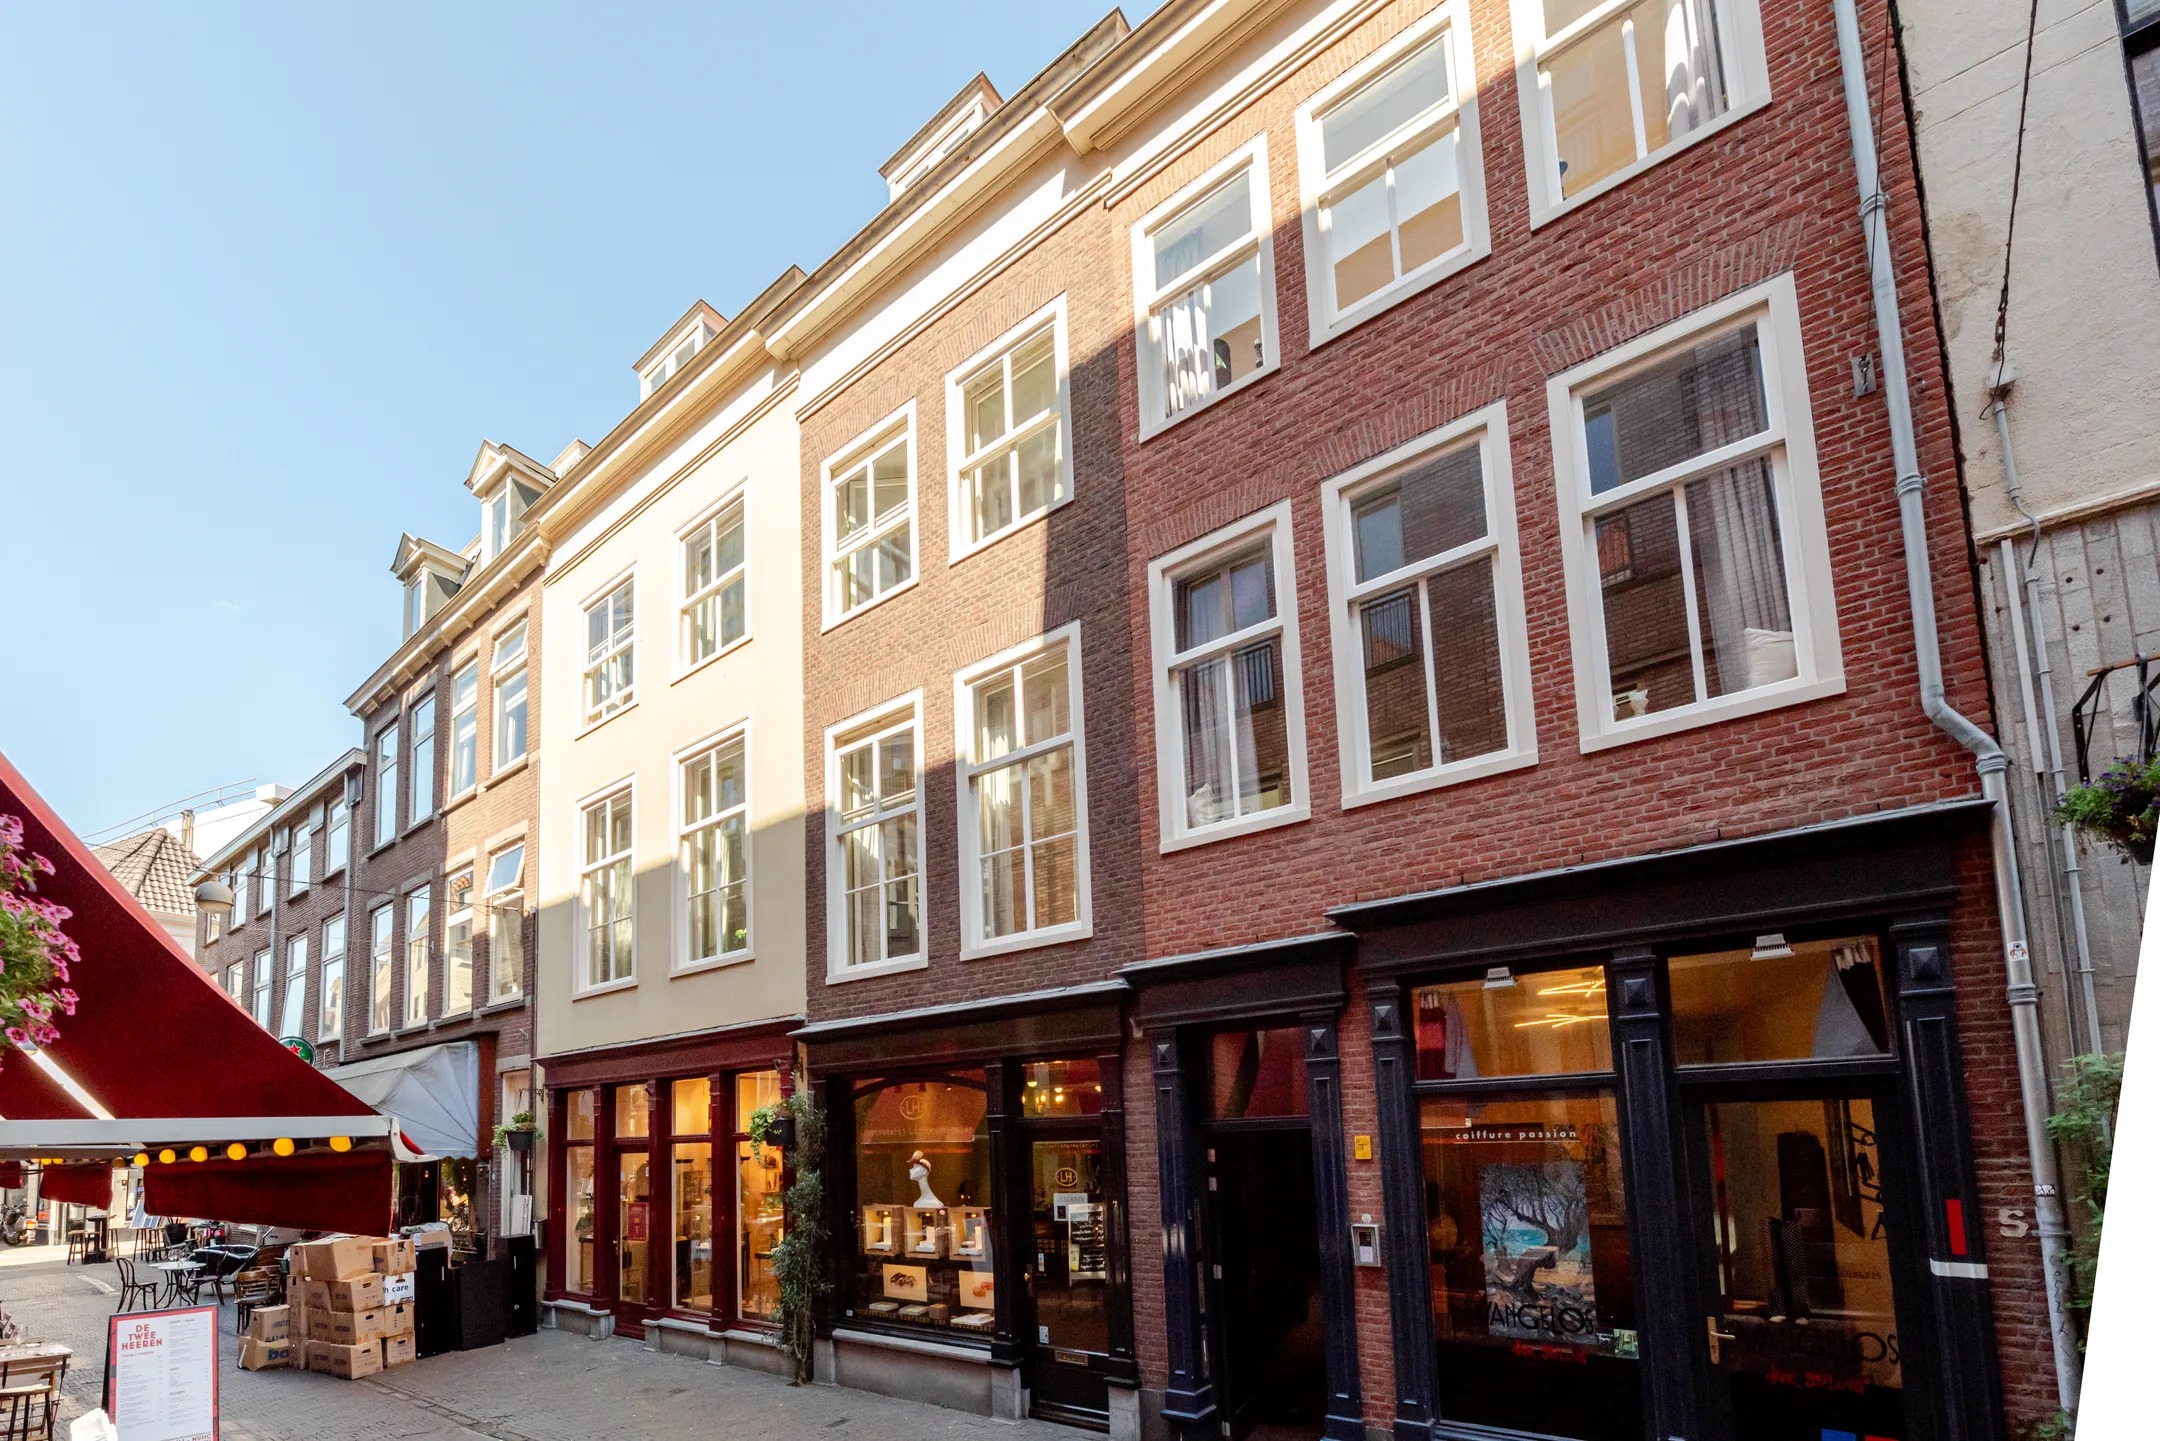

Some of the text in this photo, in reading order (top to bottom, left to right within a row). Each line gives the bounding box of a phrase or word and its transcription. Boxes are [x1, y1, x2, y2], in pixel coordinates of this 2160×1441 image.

[1455, 1129, 1577, 1140] coiffure passion
[392, 1285, 409, 1293] care
[135, 1324, 150, 1333] DE
[128, 1331, 156, 1341] TWEE
[121, 1338, 163, 1350] HEEREN
